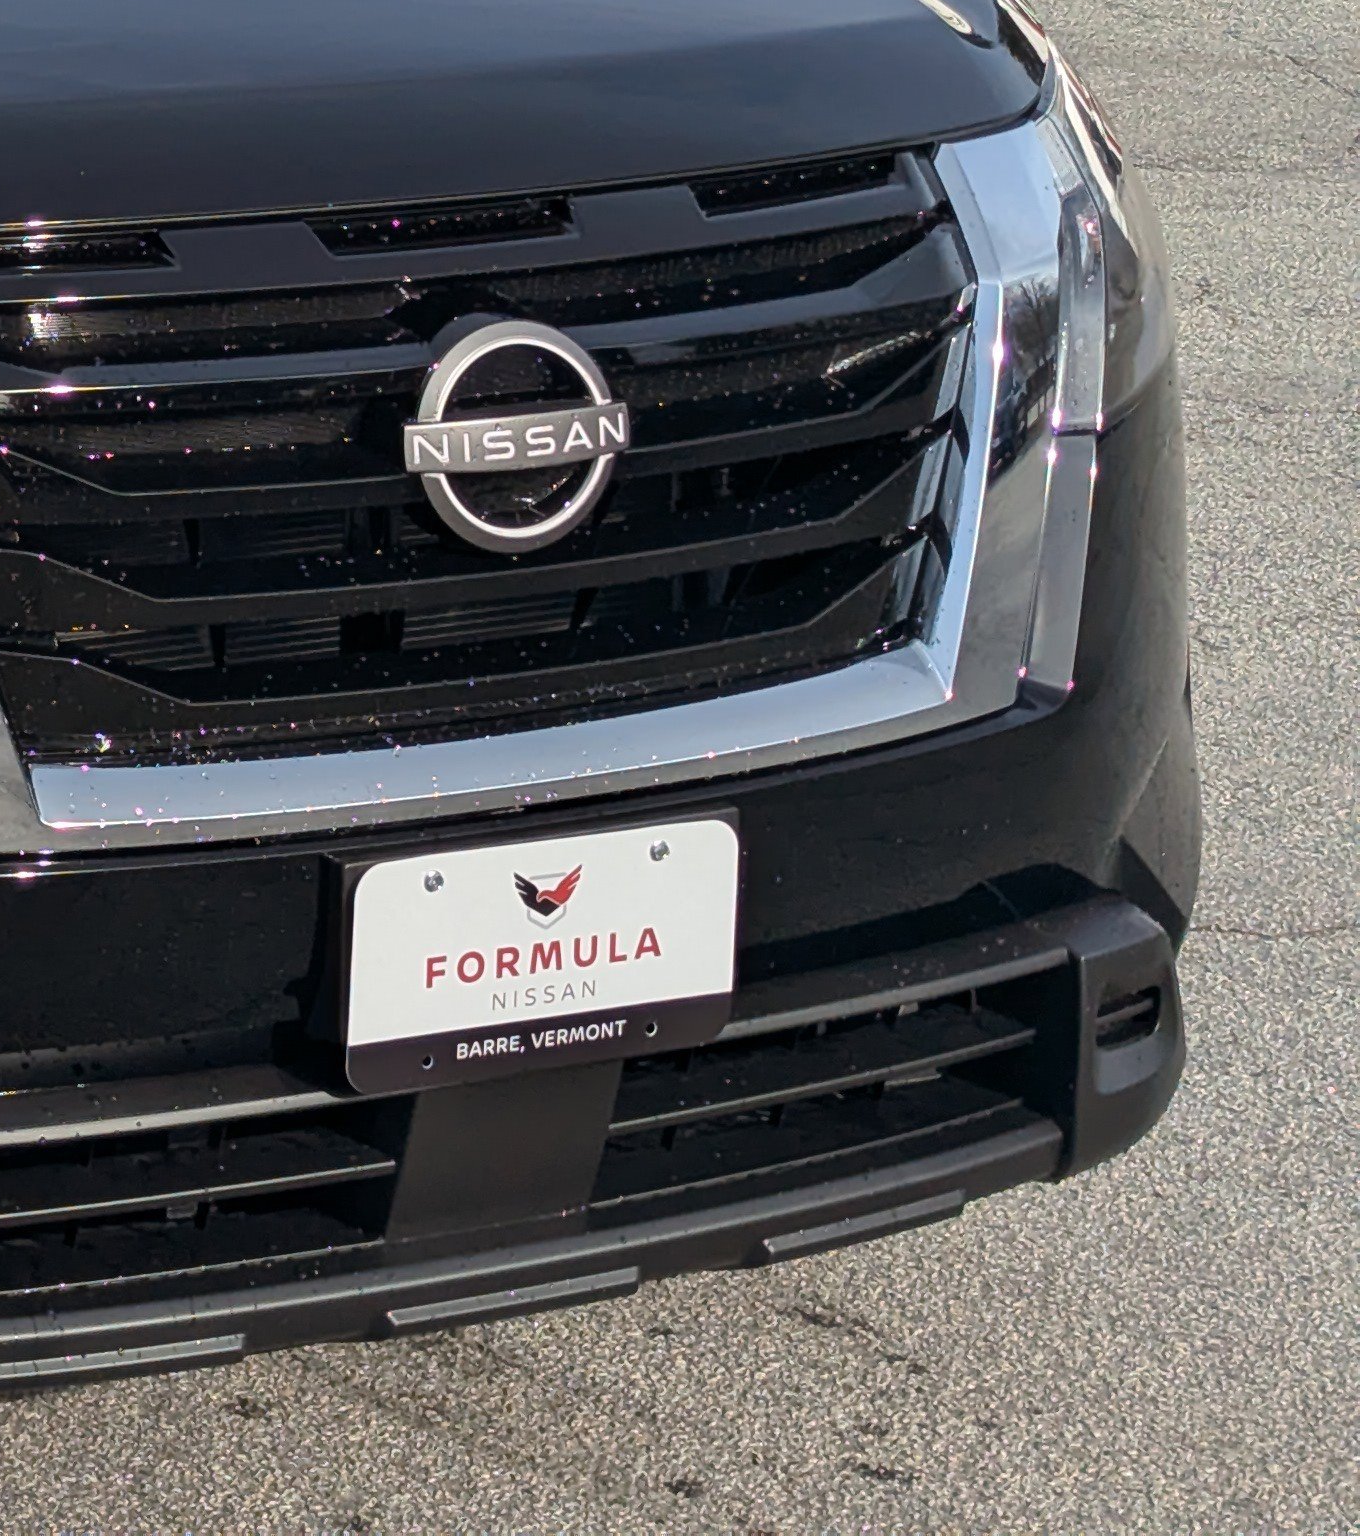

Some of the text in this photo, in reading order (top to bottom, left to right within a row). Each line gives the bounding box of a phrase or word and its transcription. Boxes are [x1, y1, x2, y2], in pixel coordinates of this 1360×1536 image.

[411, 412, 626, 465] NISSAN
[424, 927, 662, 989] FORMULA
[491, 980, 598, 1012] NISSAN
[455, 1019, 629, 1061] BARRE, VERMONT
